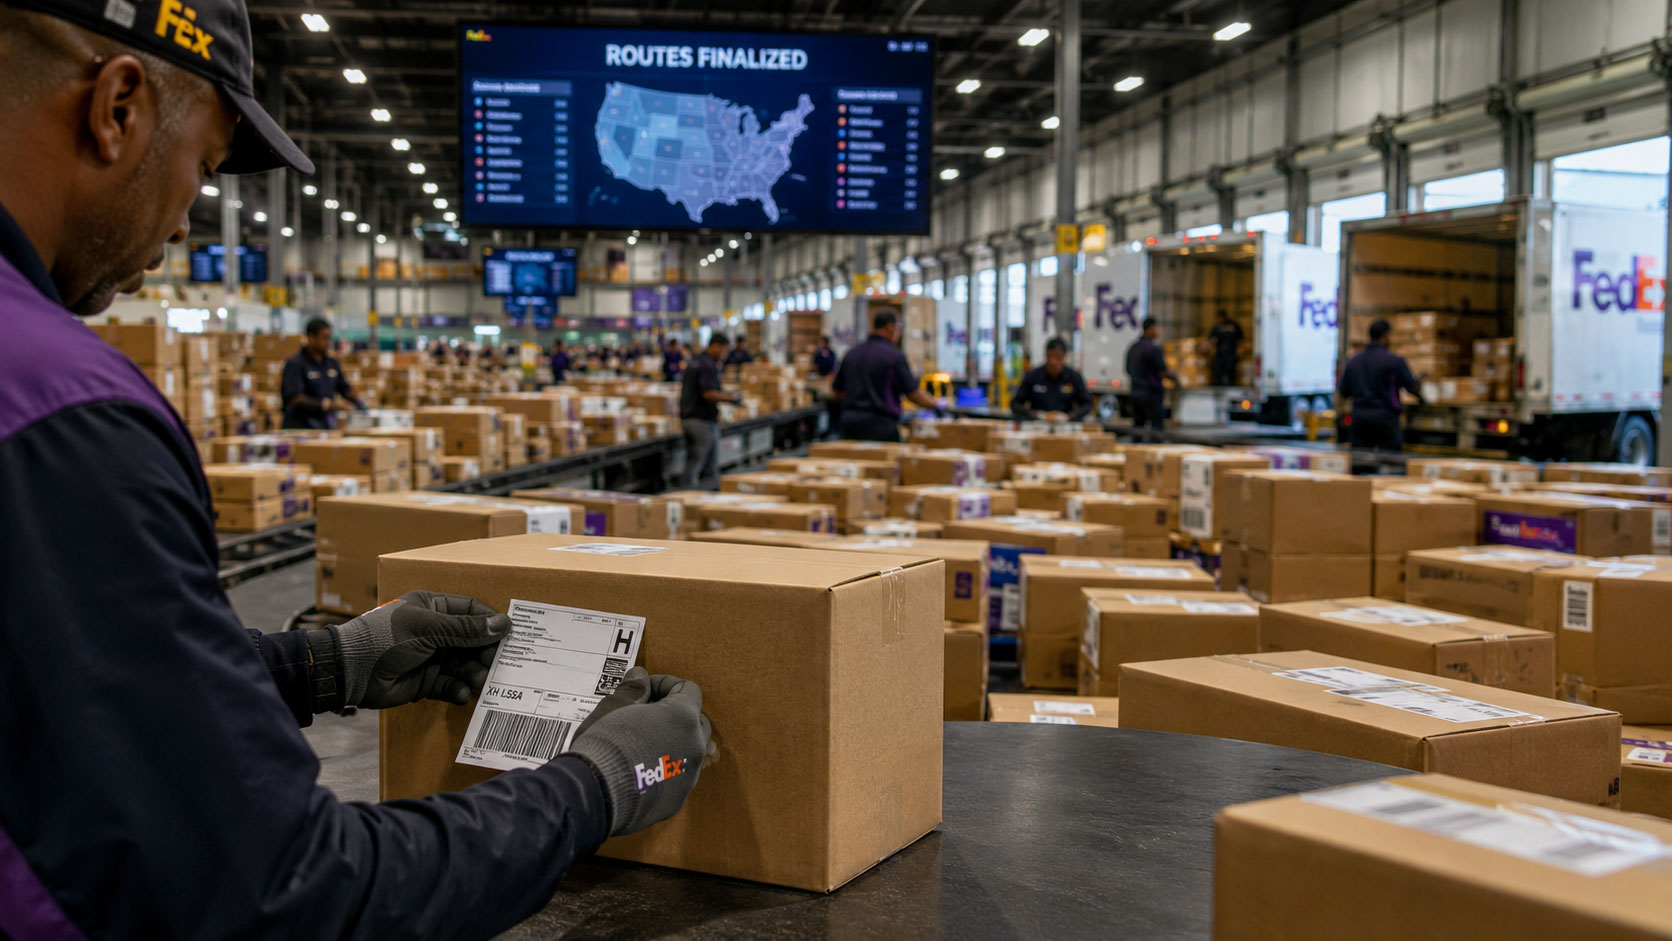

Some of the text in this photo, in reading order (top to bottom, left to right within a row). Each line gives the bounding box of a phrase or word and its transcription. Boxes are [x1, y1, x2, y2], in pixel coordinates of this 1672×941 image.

[605, 44, 808, 70] ROUTES FINALIZED
[612, 629, 634, 655] H
